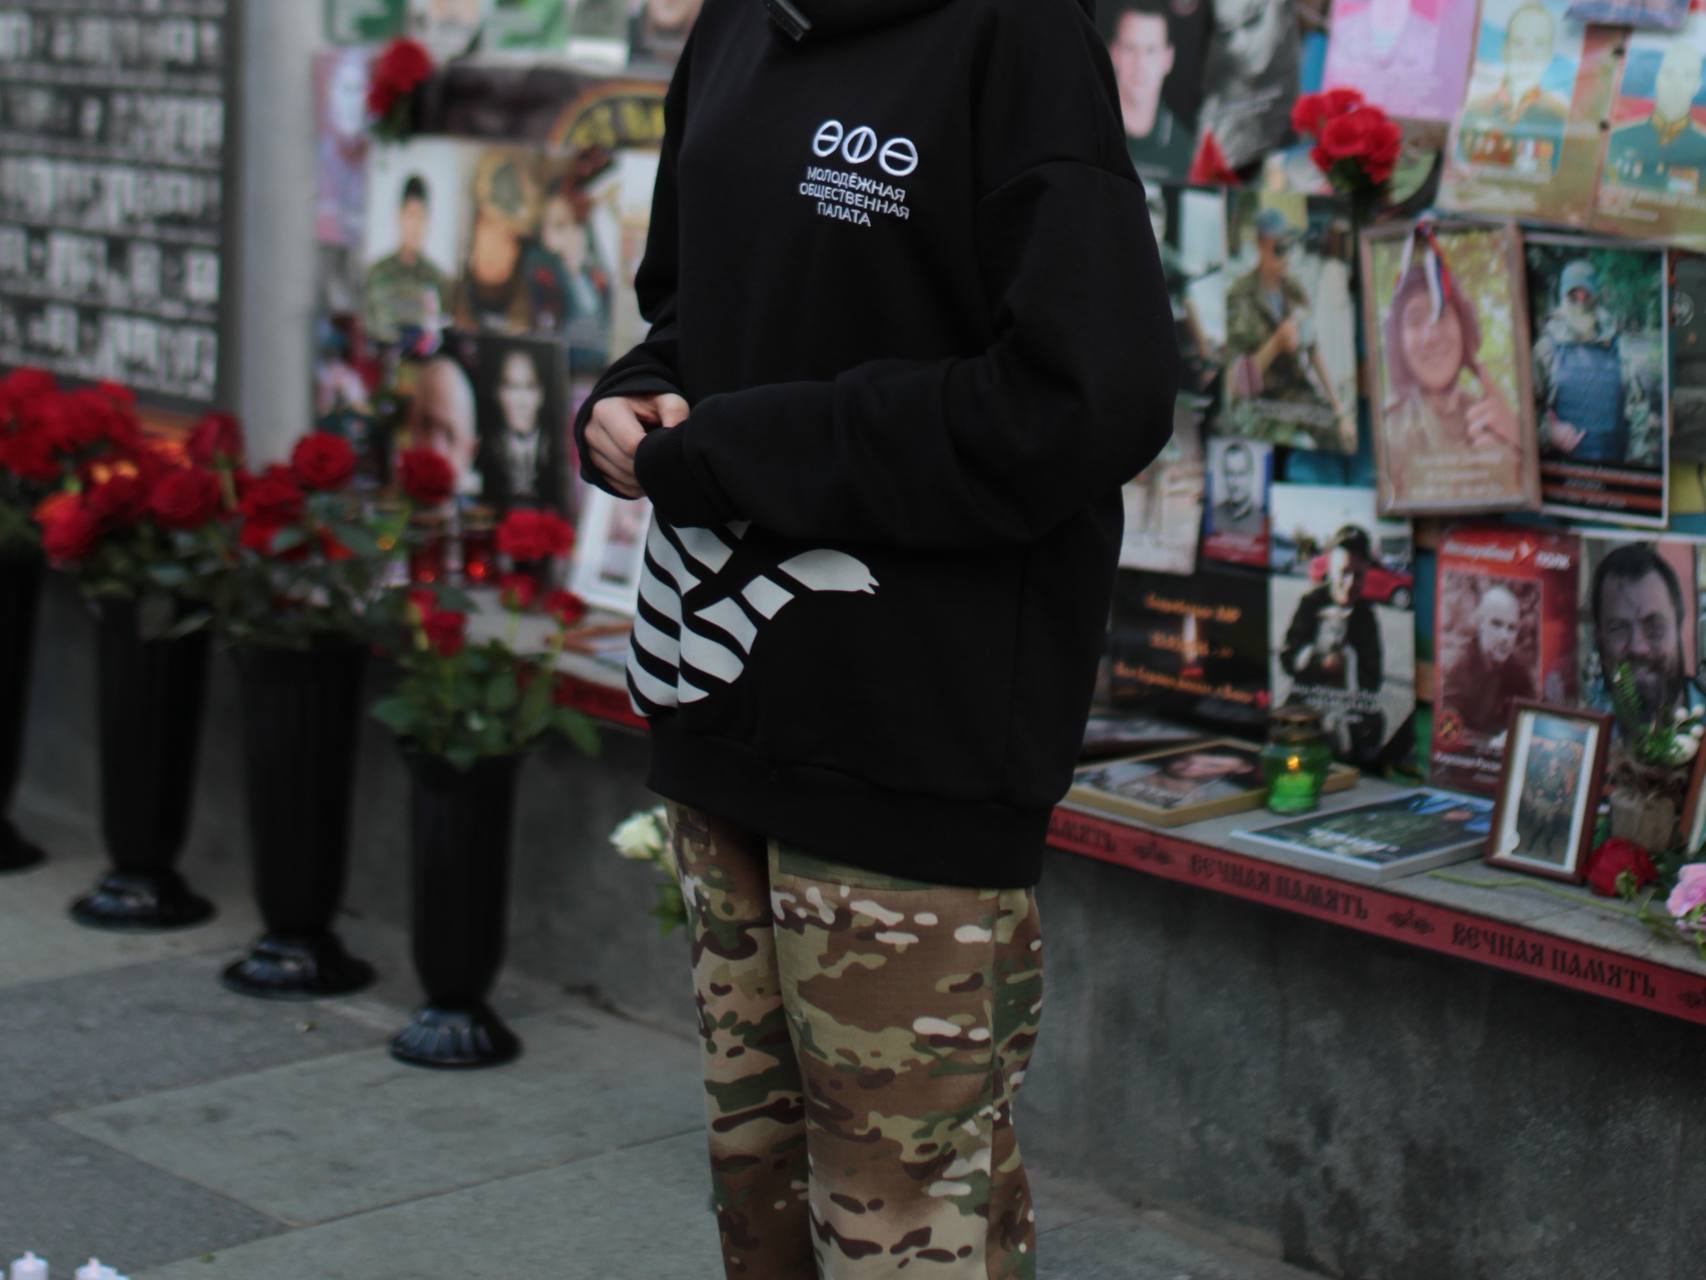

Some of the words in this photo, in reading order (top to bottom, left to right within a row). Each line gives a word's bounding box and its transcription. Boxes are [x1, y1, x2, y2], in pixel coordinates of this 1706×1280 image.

[800, 182, 909, 220] ОБЩЕСТВЕННАЯ
[807, 167, 905, 202] МОЛОДЁЖНАЯ
[817, 201, 871, 227] ПАЛАТА
[1049, 816, 1117, 853] АМЯТЬ
[1189, 853, 1271, 894] ВЕЧНАЯ
[1276, 875, 1368, 920] ПАМЯТЬ
[1452, 922, 1544, 966] ВЕЧНАЯ
[1551, 948, 1656, 998] ПАМЯТЬ
